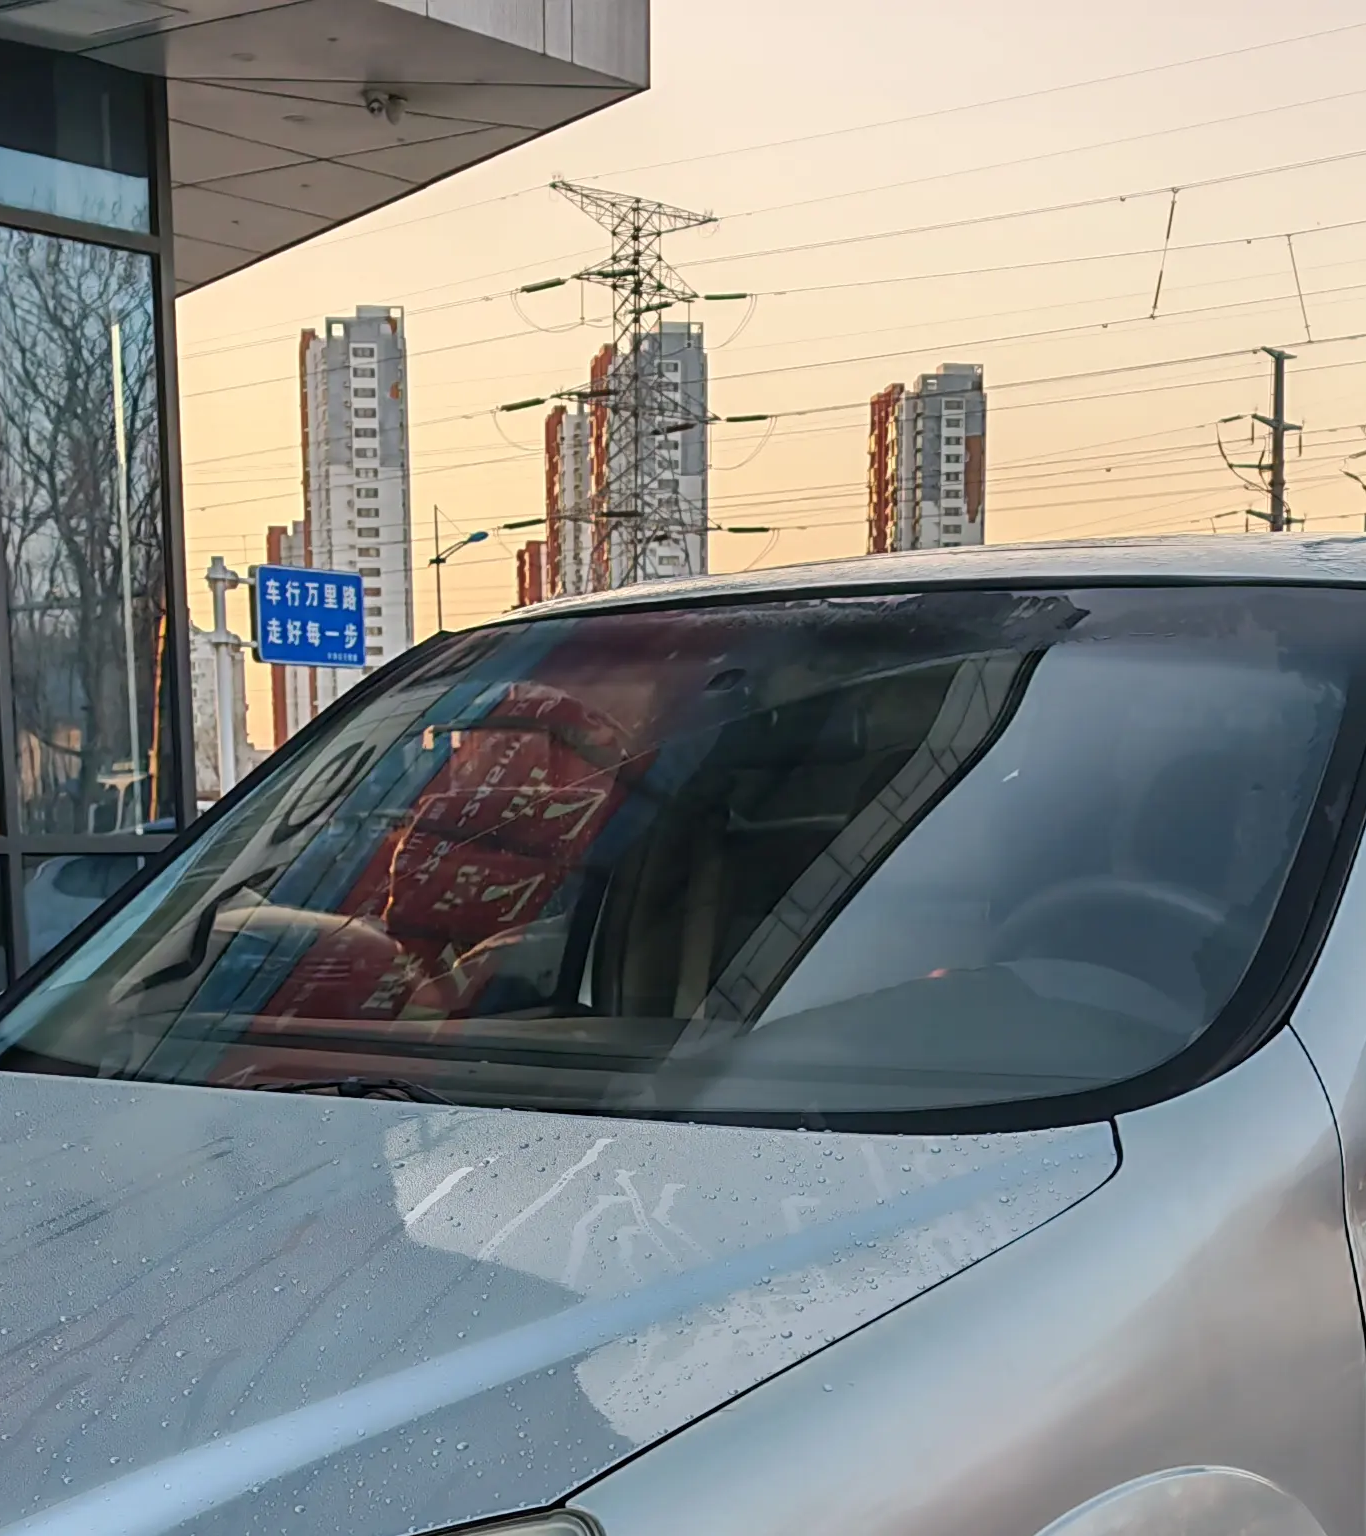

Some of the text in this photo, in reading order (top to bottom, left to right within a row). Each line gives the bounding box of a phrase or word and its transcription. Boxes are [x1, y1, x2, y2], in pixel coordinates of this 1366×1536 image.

[265, 578, 357, 611] 车行万里路
[266, 618, 358, 649] 走好每一步
